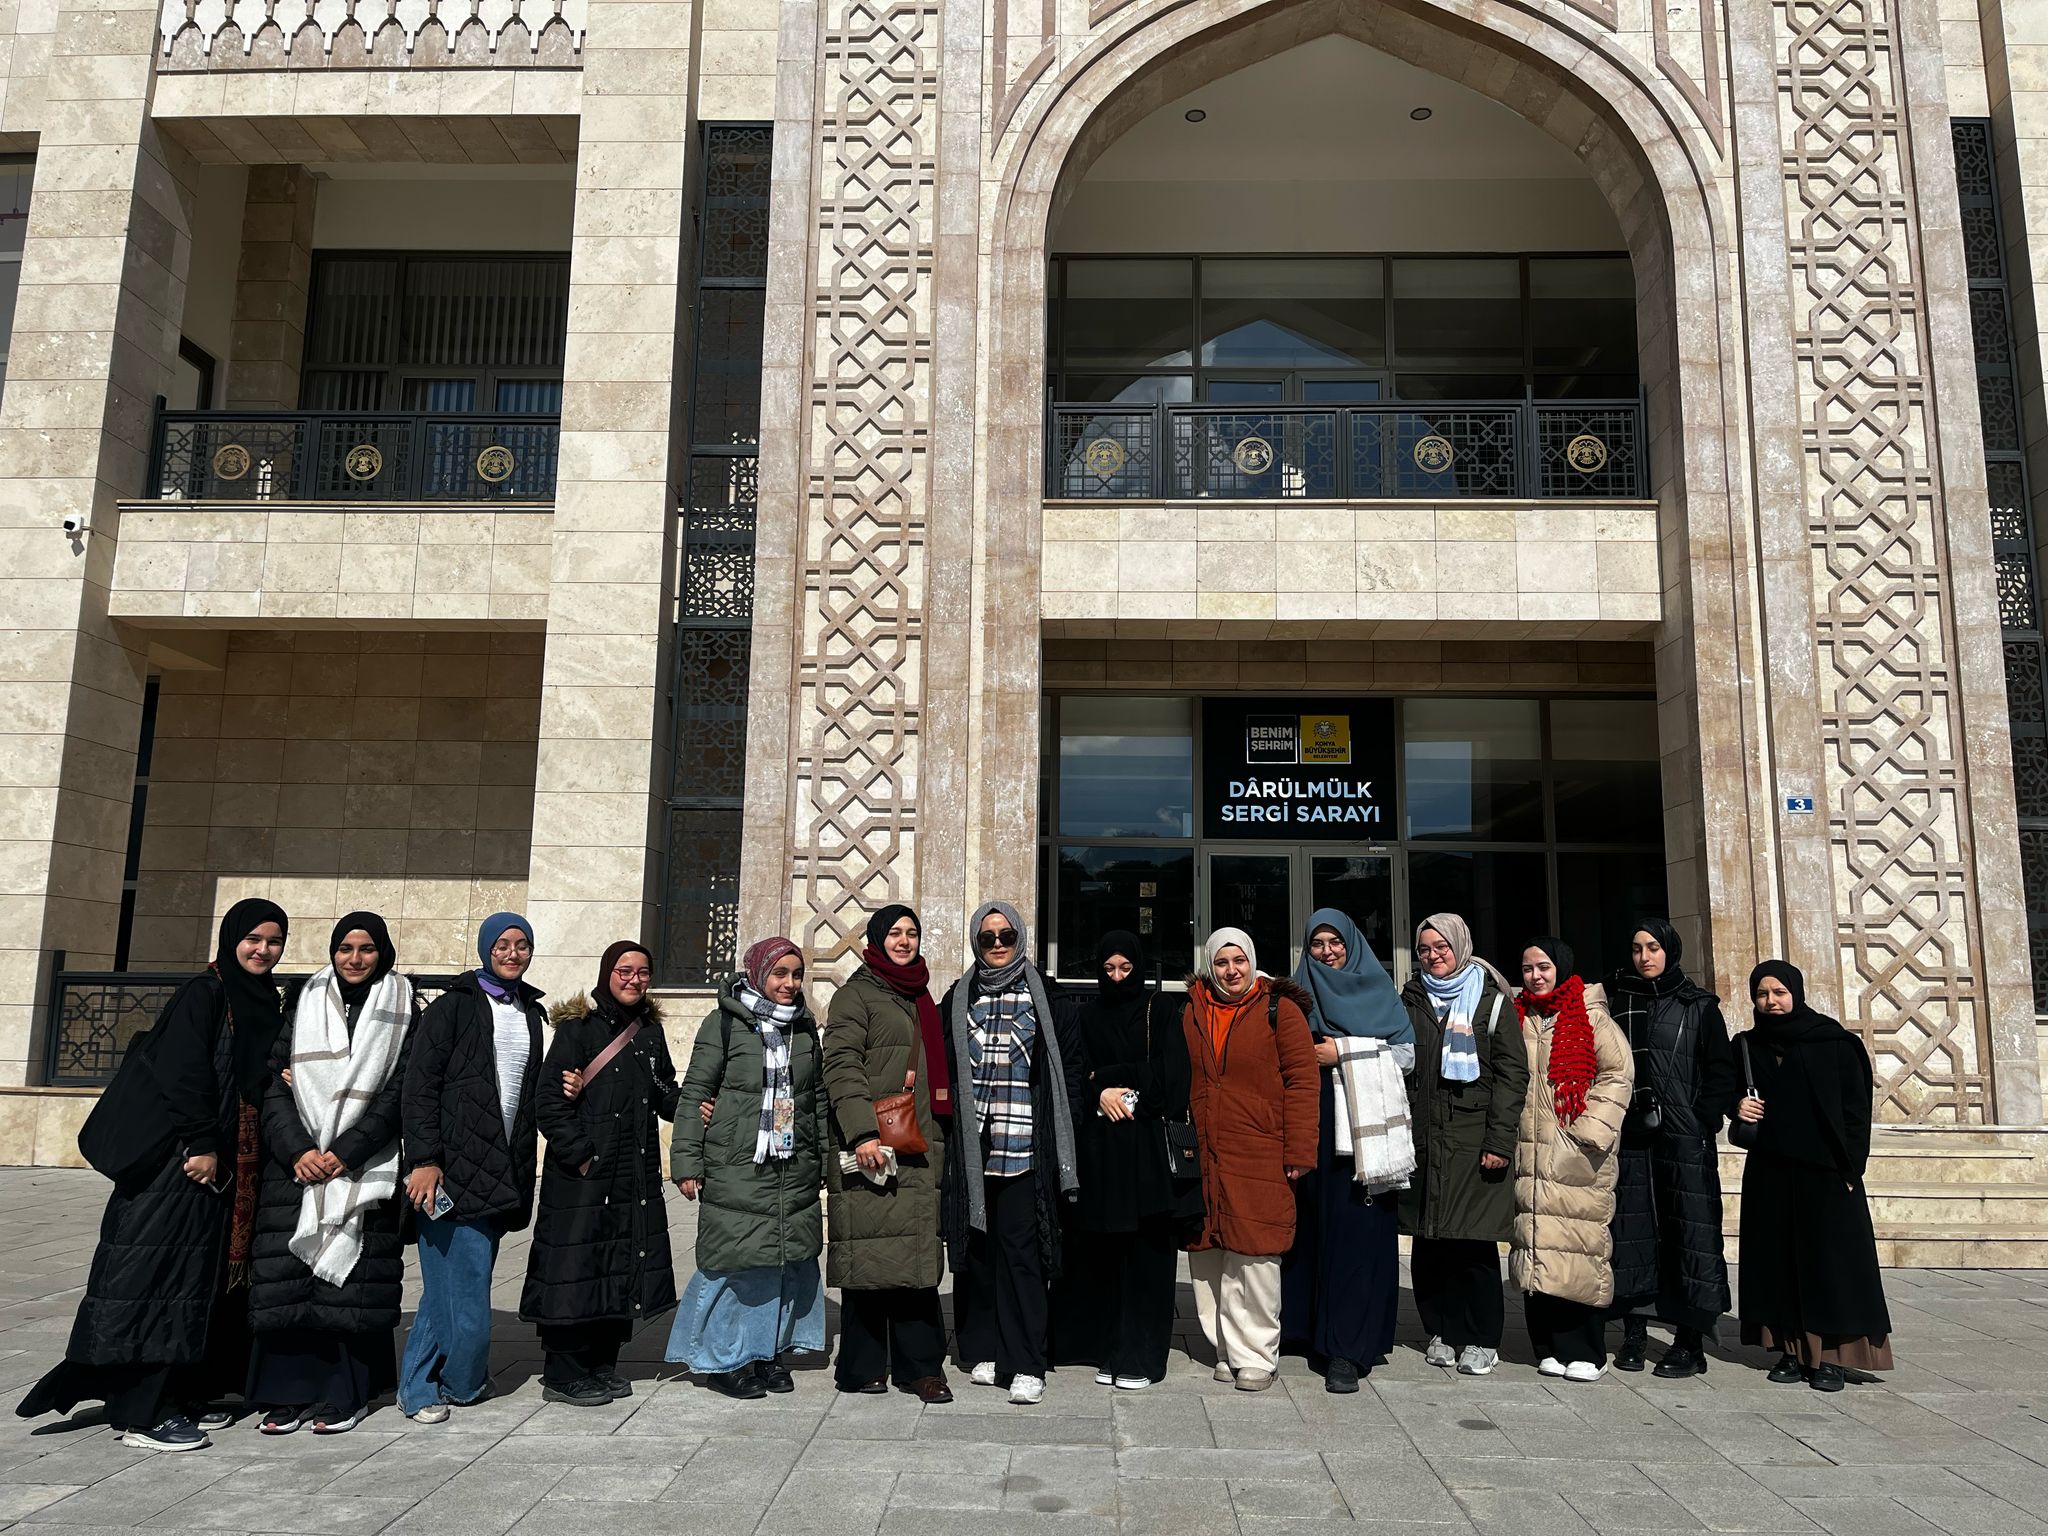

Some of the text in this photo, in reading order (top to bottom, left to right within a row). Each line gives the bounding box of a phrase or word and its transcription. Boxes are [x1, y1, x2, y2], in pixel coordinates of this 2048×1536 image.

[1229, 777, 1373, 798] DÂRÜLMÜLK
[1221, 802, 1380, 823] SERGİ SARAYI
[1794, 799, 1806, 810] 3
